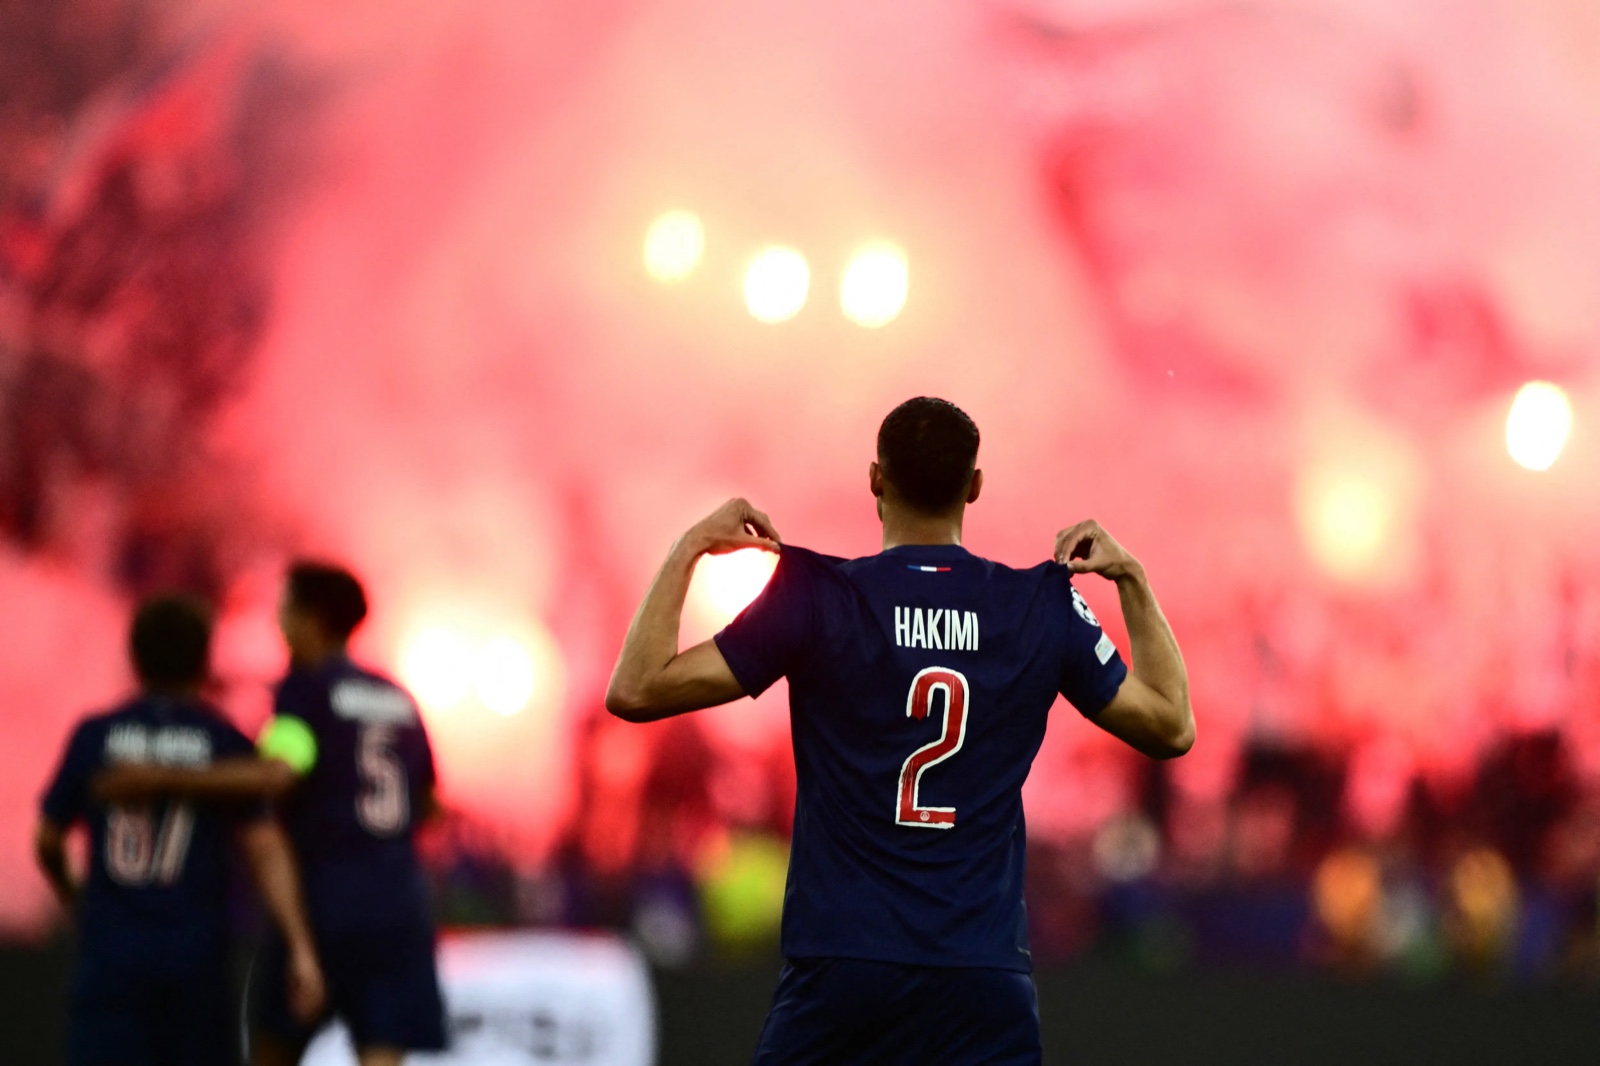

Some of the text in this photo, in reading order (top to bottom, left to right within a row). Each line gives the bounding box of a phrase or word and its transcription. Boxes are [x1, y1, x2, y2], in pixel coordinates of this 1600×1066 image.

[894, 606, 979, 651] HAKIMI
[353, 724, 411, 838] 5
[895, 666, 969, 829] 2
